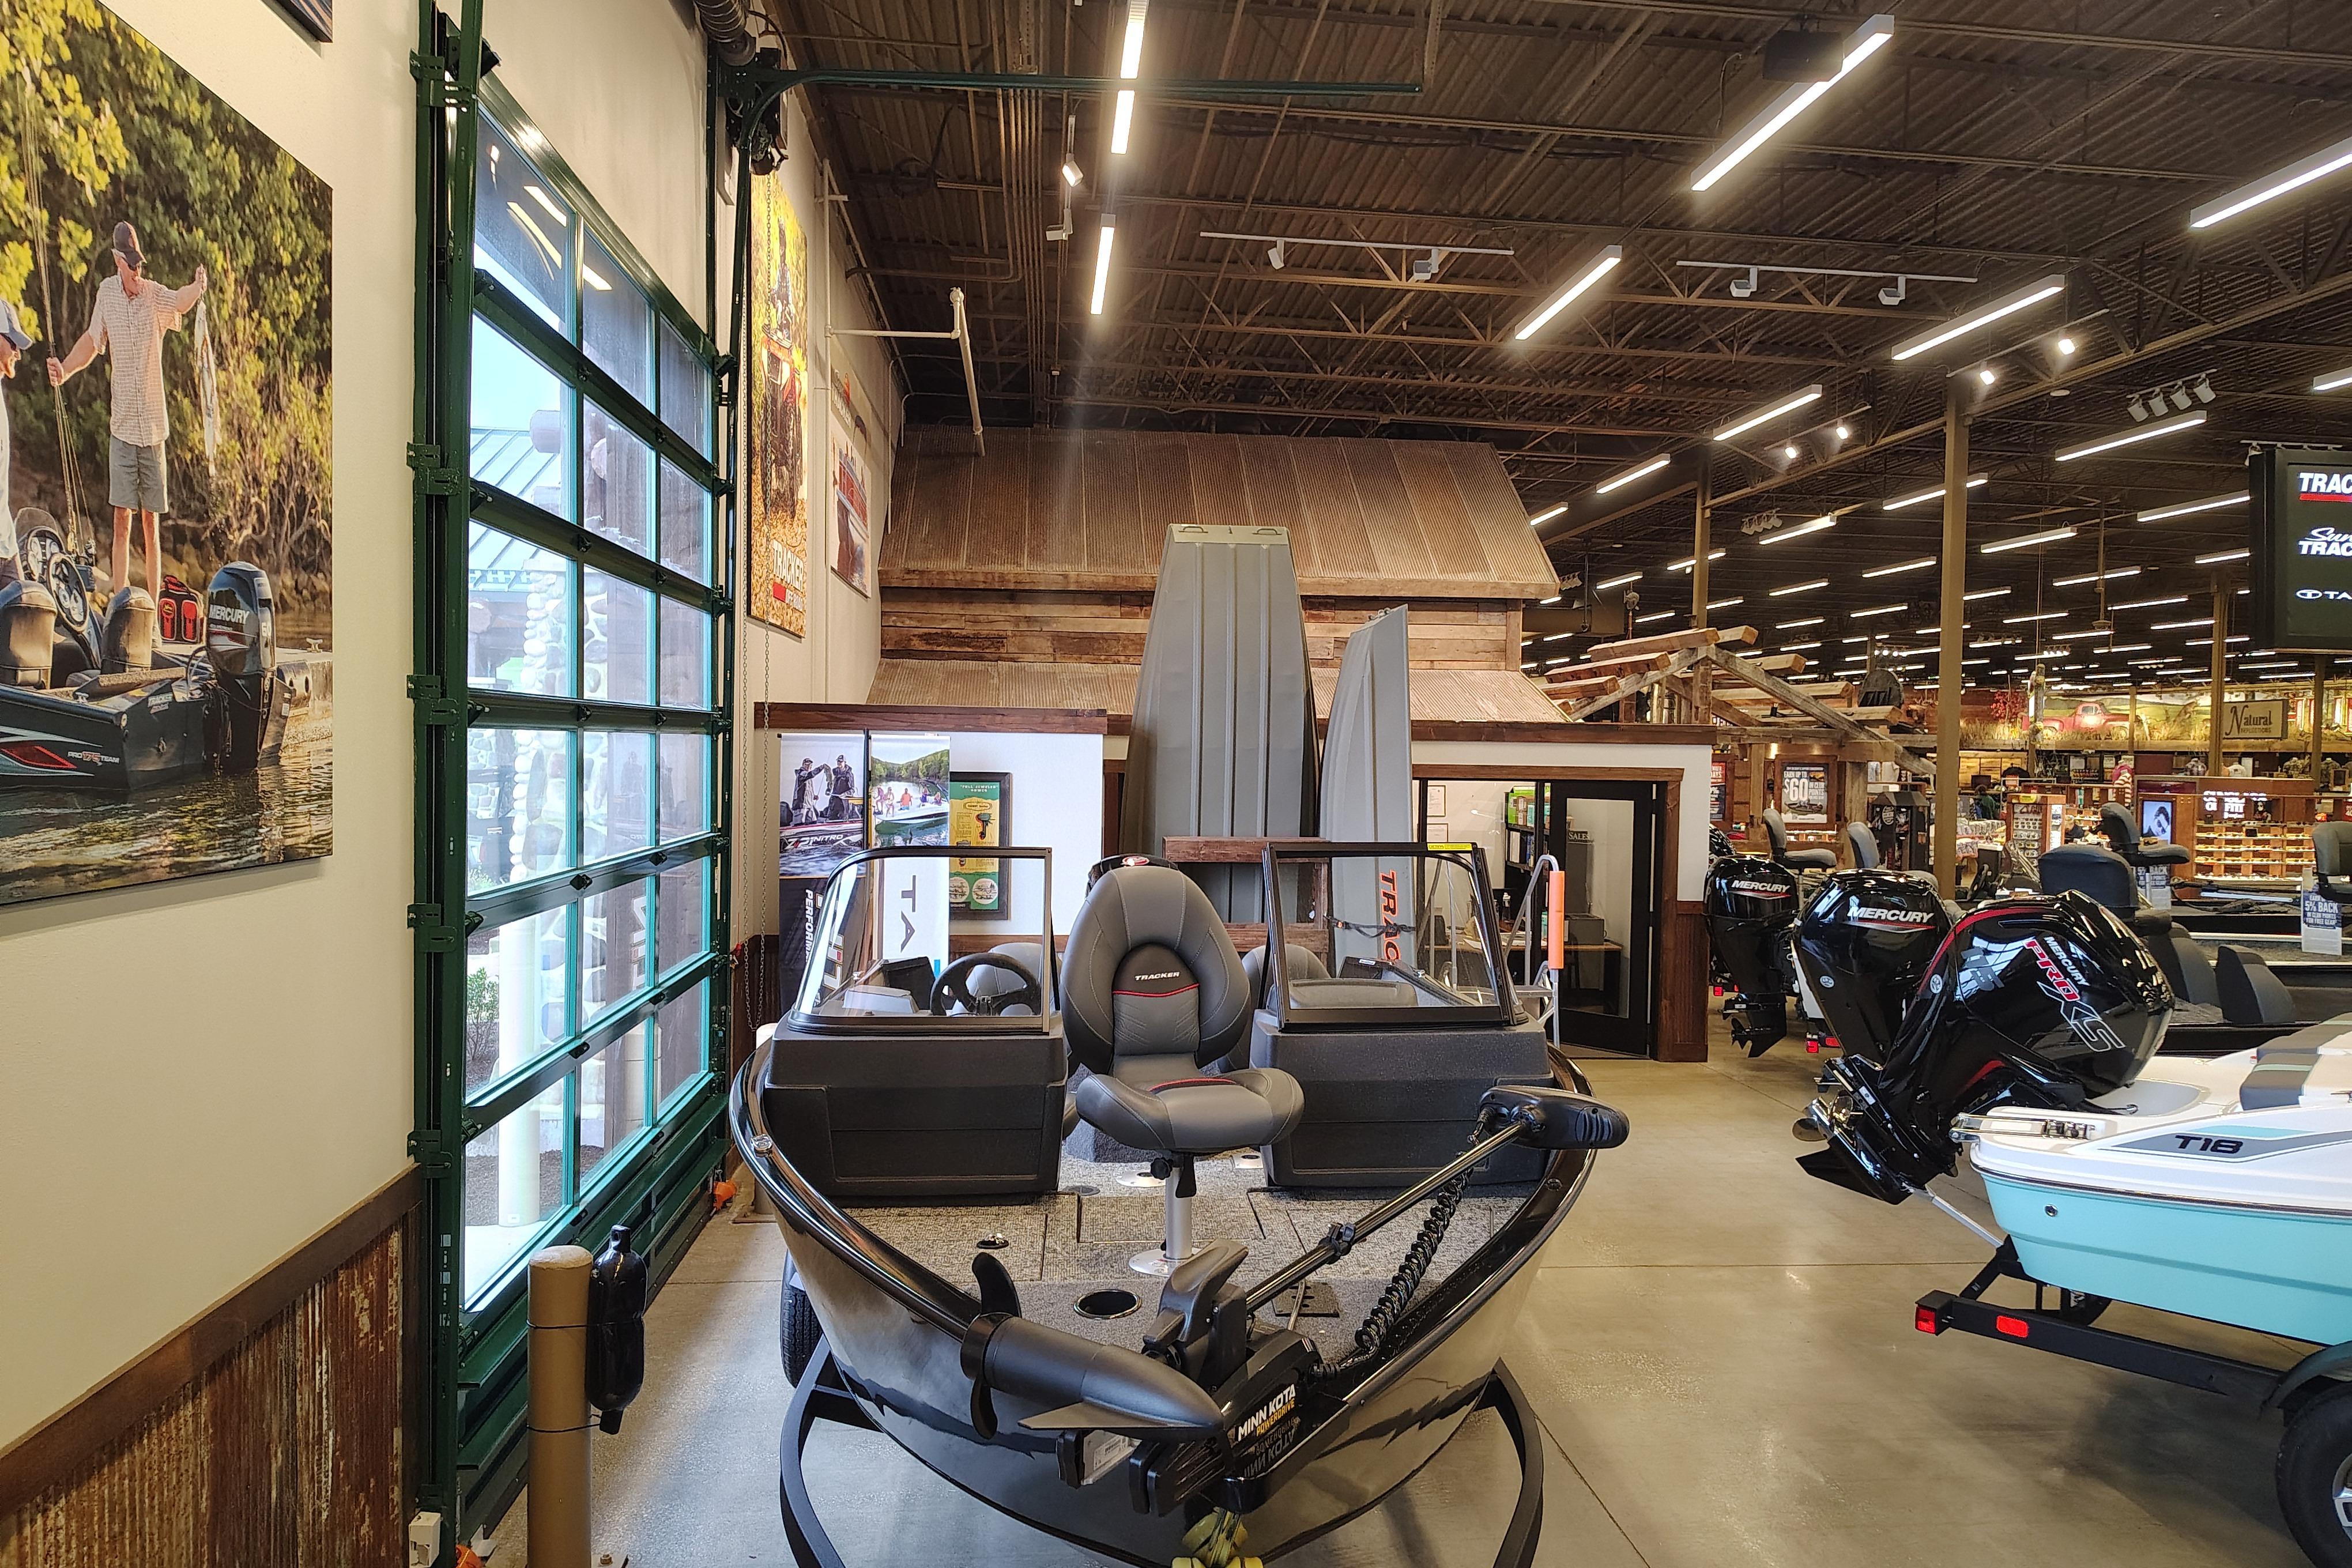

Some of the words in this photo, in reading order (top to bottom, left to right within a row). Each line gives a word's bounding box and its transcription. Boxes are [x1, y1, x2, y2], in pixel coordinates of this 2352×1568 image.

[2299, 473, 2352, 494] TRAC
[2298, 541, 2352, 556] TRAC
[772, 538, 804, 593] TRACKER
[209, 604, 250, 624] MERCURY
[2225, 704, 2273, 736] Natural
[101, 755, 120, 764] TEAM
[1784, 778, 1808, 801] $60
[1569, 832, 1590, 840] SALES
[1731, 880, 1791, 892] MERCURY
[1847, 907, 1934, 923] MERCURY
[2305, 900, 2316, 911] 5%
[2318, 902, 2338, 913] BACK
[2022, 938, 2080, 1002] PRO
[2044, 936, 2091, 986] MERCURY
[1135, 971, 1179, 981] TRACKER
[2037, 981, 2126, 1052] XS
[2174, 1134, 2244, 1154] T18
[1238, 1405, 1267, 1441] MINN
[1269, 1384, 1296, 1416] KOTA
[1256, 1398, 1295, 1437] POWERDRIVE
